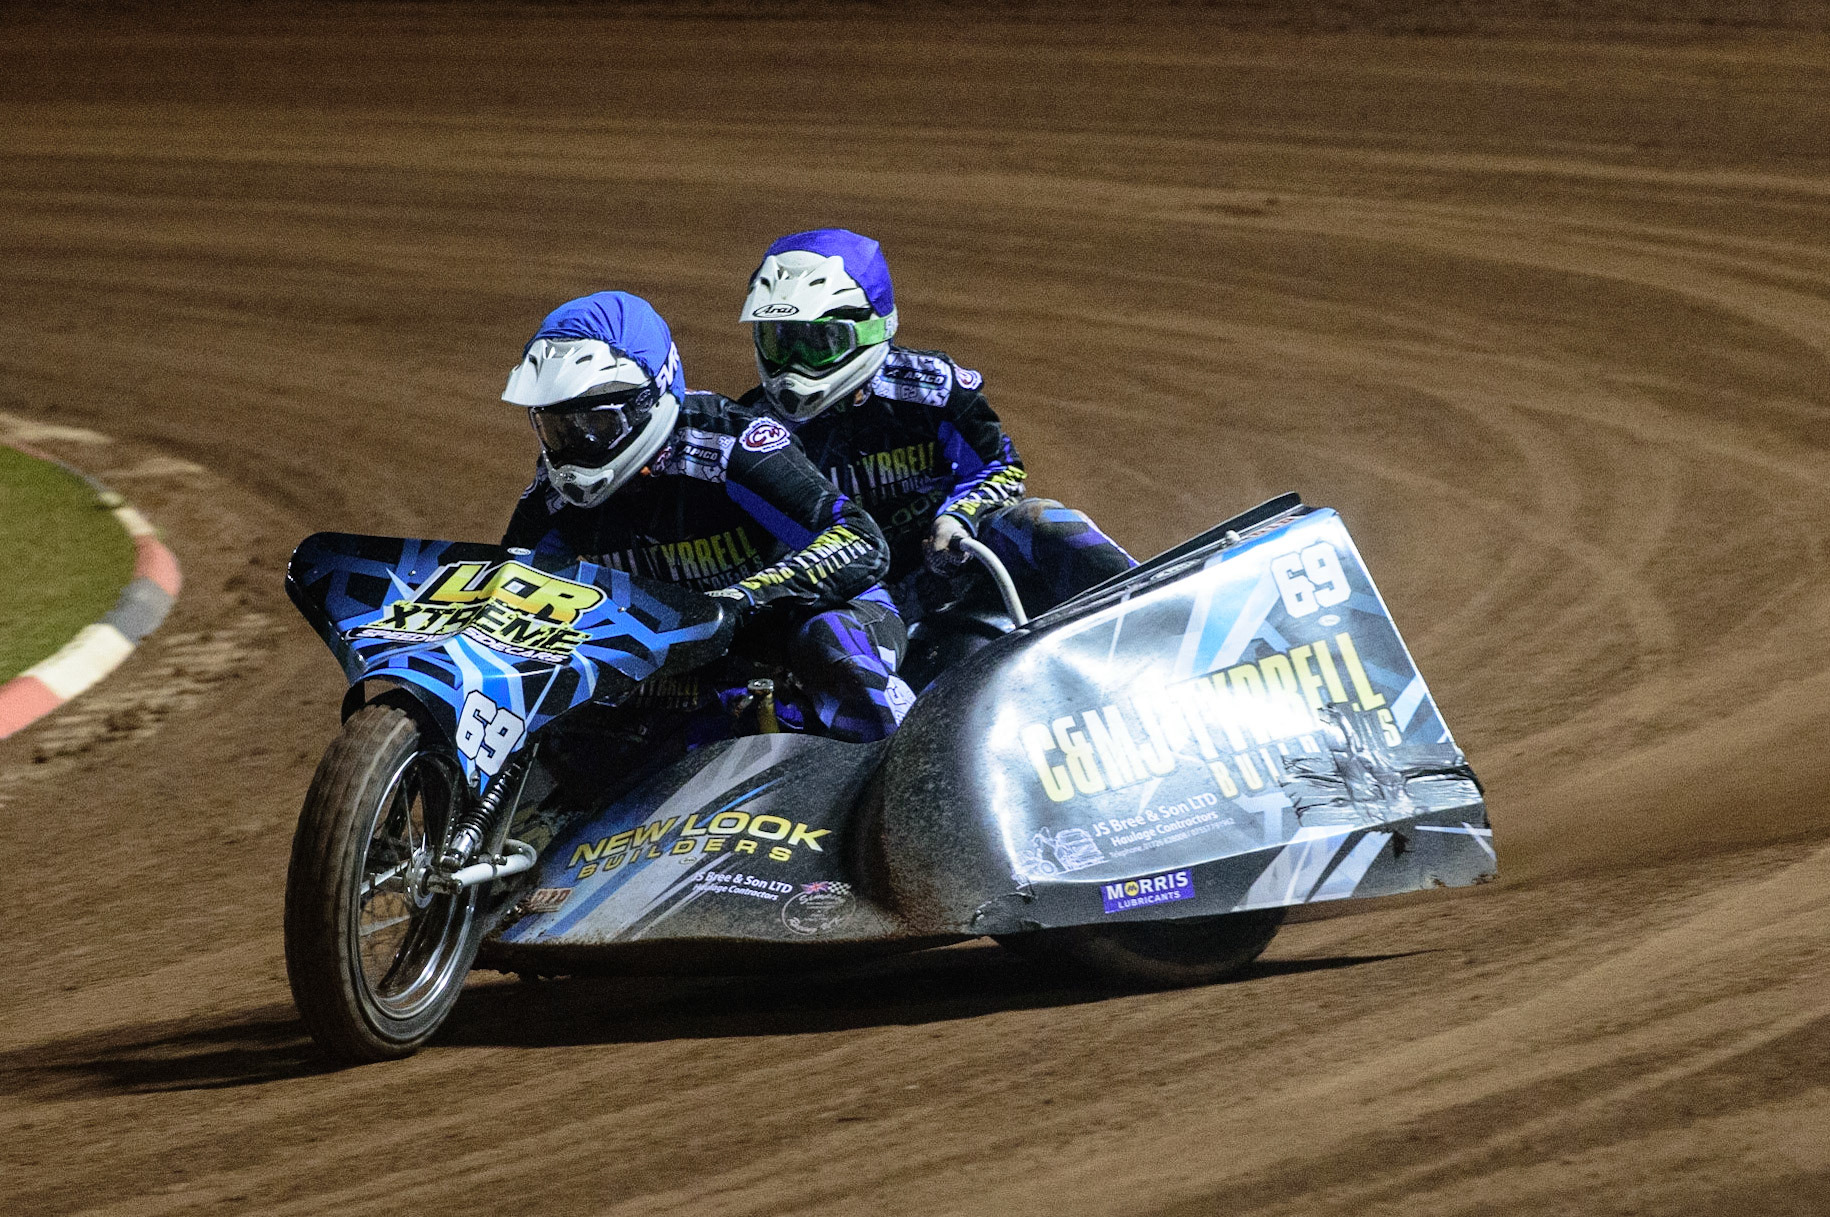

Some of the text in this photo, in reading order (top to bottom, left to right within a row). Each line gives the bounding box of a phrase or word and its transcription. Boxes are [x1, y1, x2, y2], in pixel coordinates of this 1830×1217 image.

[763, 304, 793, 314] Arai
[1270, 541, 1351, 618] 69
[463, 626, 568, 663] SIDECARS
[456, 690, 526, 777] 69
[1092, 792, 1218, 837] JS Bree & Son LTD
[1110, 829, 1157, 847] Haulage
[1155, 810, 1219, 834] Contractors
[568, 811, 832, 868] NEW LOOK
[576, 838, 793, 881] BUILDERS
[705, 871, 732, 883] Bree
[733, 873, 744, 884] &
[743, 875, 768, 889] Son
[768, 880, 794, 894] LTD
[727, 885, 779, 901] Contractors
[1105, 871, 1189, 900] MORRIS
[1117, 890, 1182, 910] LUBRICANTS
